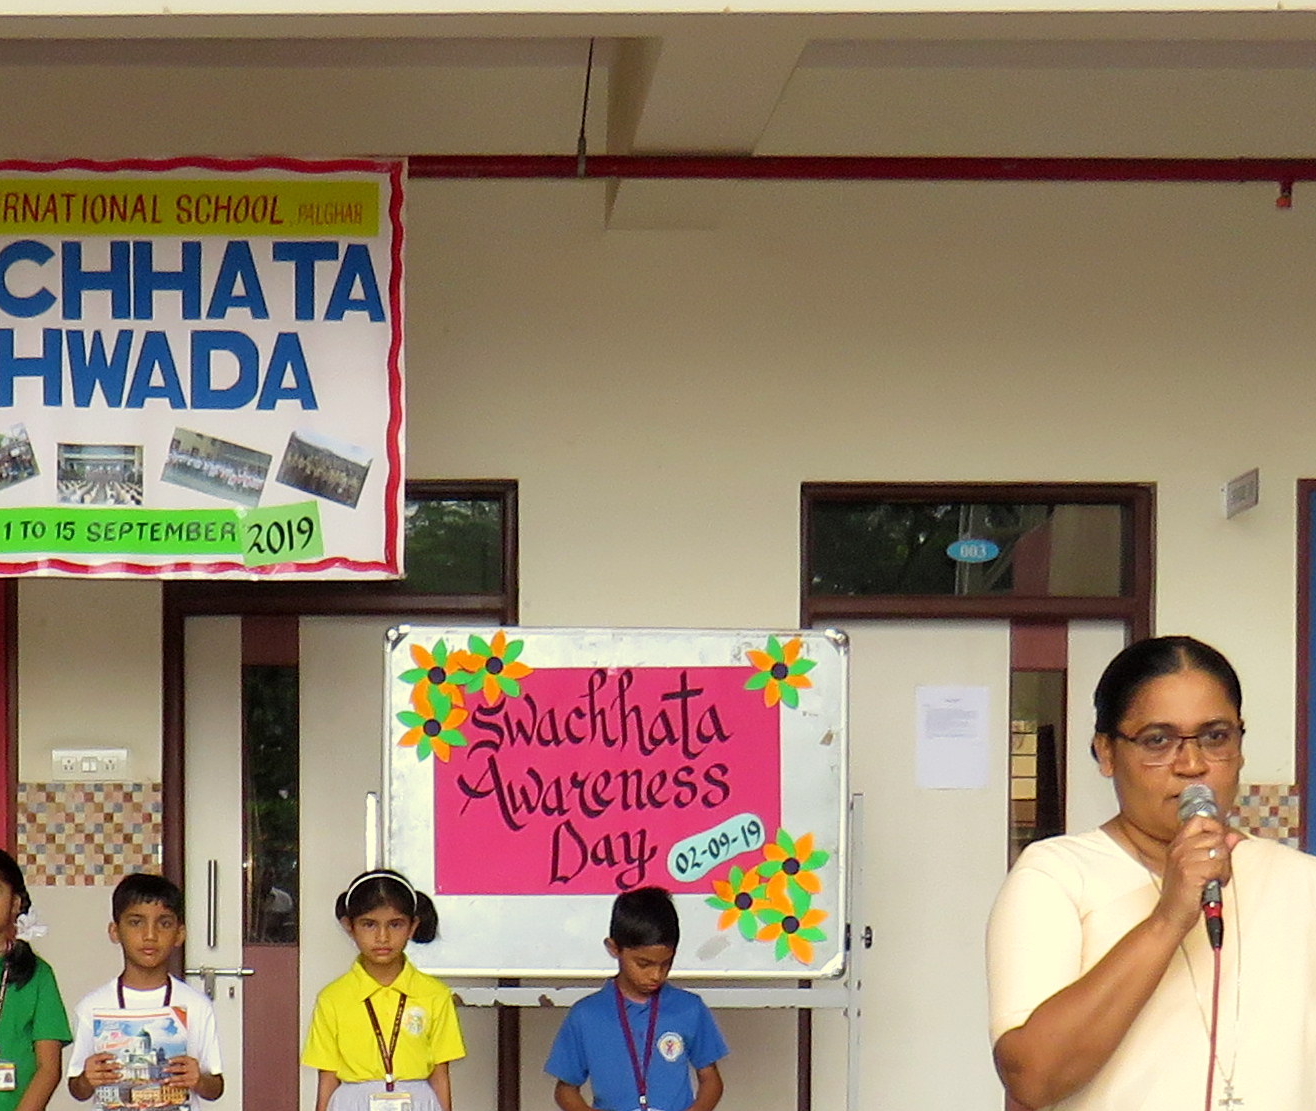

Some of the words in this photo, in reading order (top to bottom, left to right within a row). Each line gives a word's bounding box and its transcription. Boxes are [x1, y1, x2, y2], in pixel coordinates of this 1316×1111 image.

[174, 192, 284, 225] SCHOOL
[2, 521, 12, 541] 1
[20, 521, 47, 540] TO
[55, 521, 76, 541] 15
[86, 520, 237, 543] SEPTEMBER
[246, 516, 315, 555] 2019
[466, 668, 735, 761] Swachhata
[457, 754, 732, 832] Awareness
[548, 820, 657, 890] Day
[674, 819, 762, 876] 02-09-19
